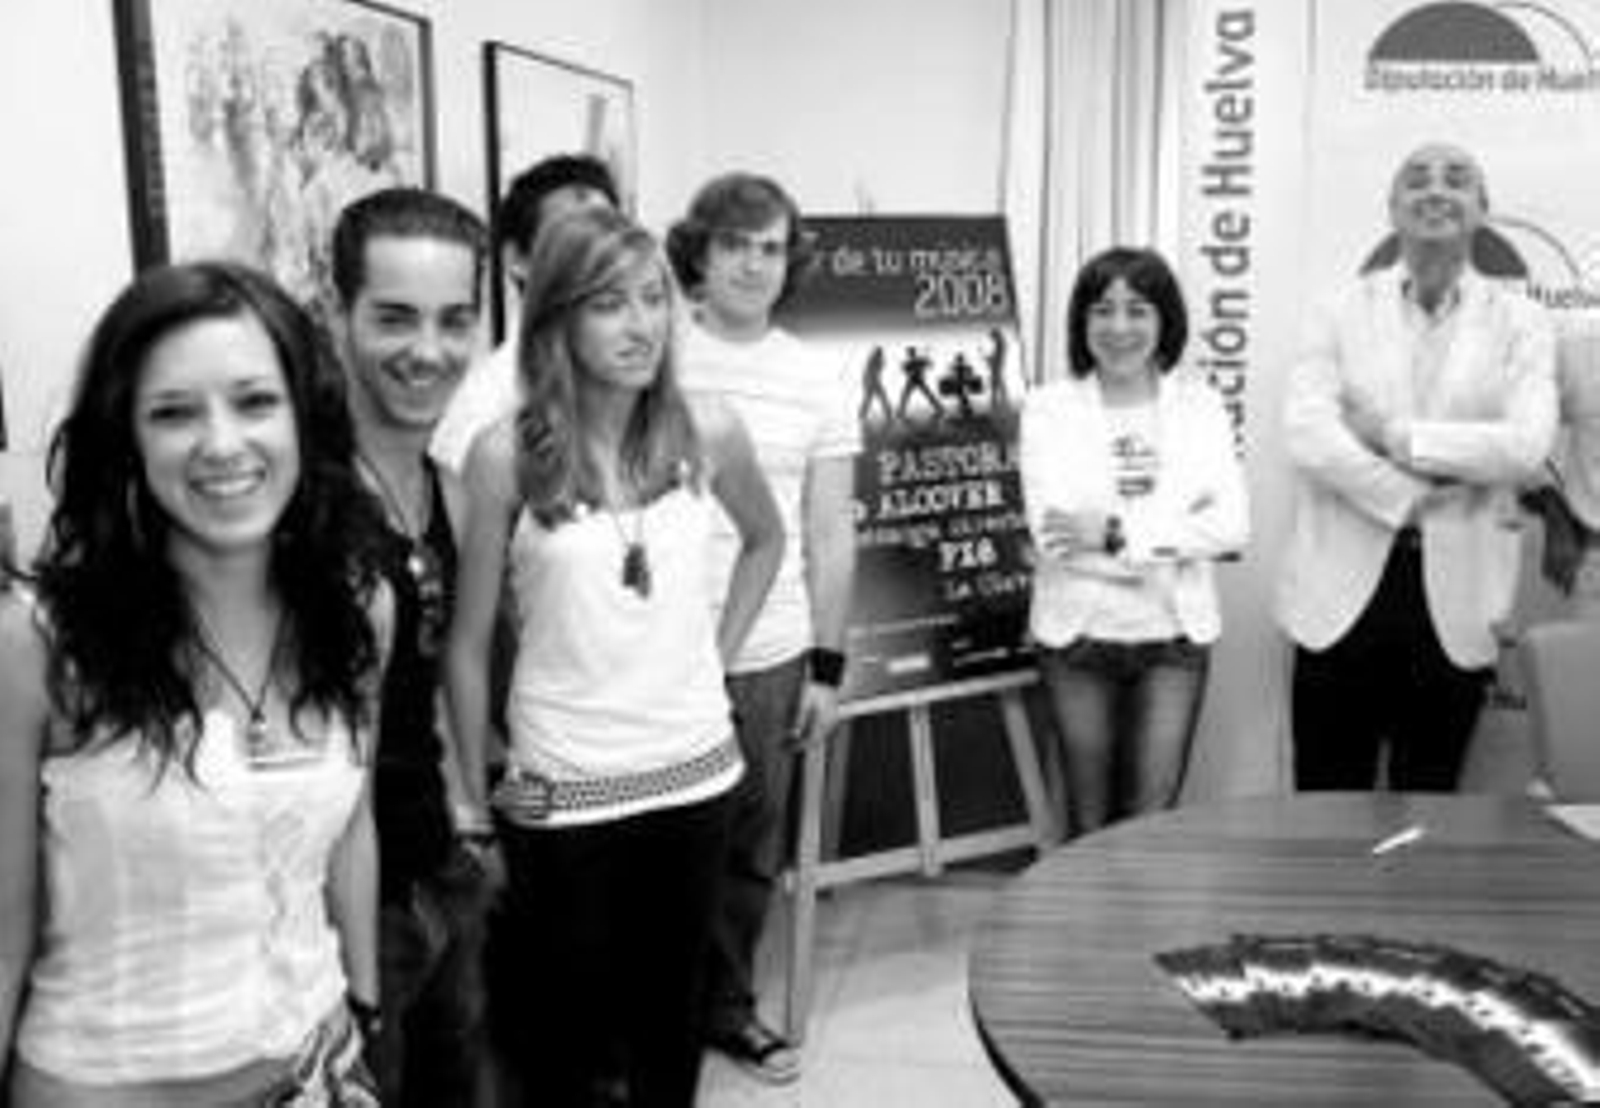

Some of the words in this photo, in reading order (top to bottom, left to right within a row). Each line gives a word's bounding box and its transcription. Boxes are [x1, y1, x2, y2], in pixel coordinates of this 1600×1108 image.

[1202, 9, 1255, 197] Huelva
[832, 247, 867, 275] de
[872, 247, 901, 275] tu
[1199, 211, 1252, 277] de
[914, 272, 1006, 318] 2008
